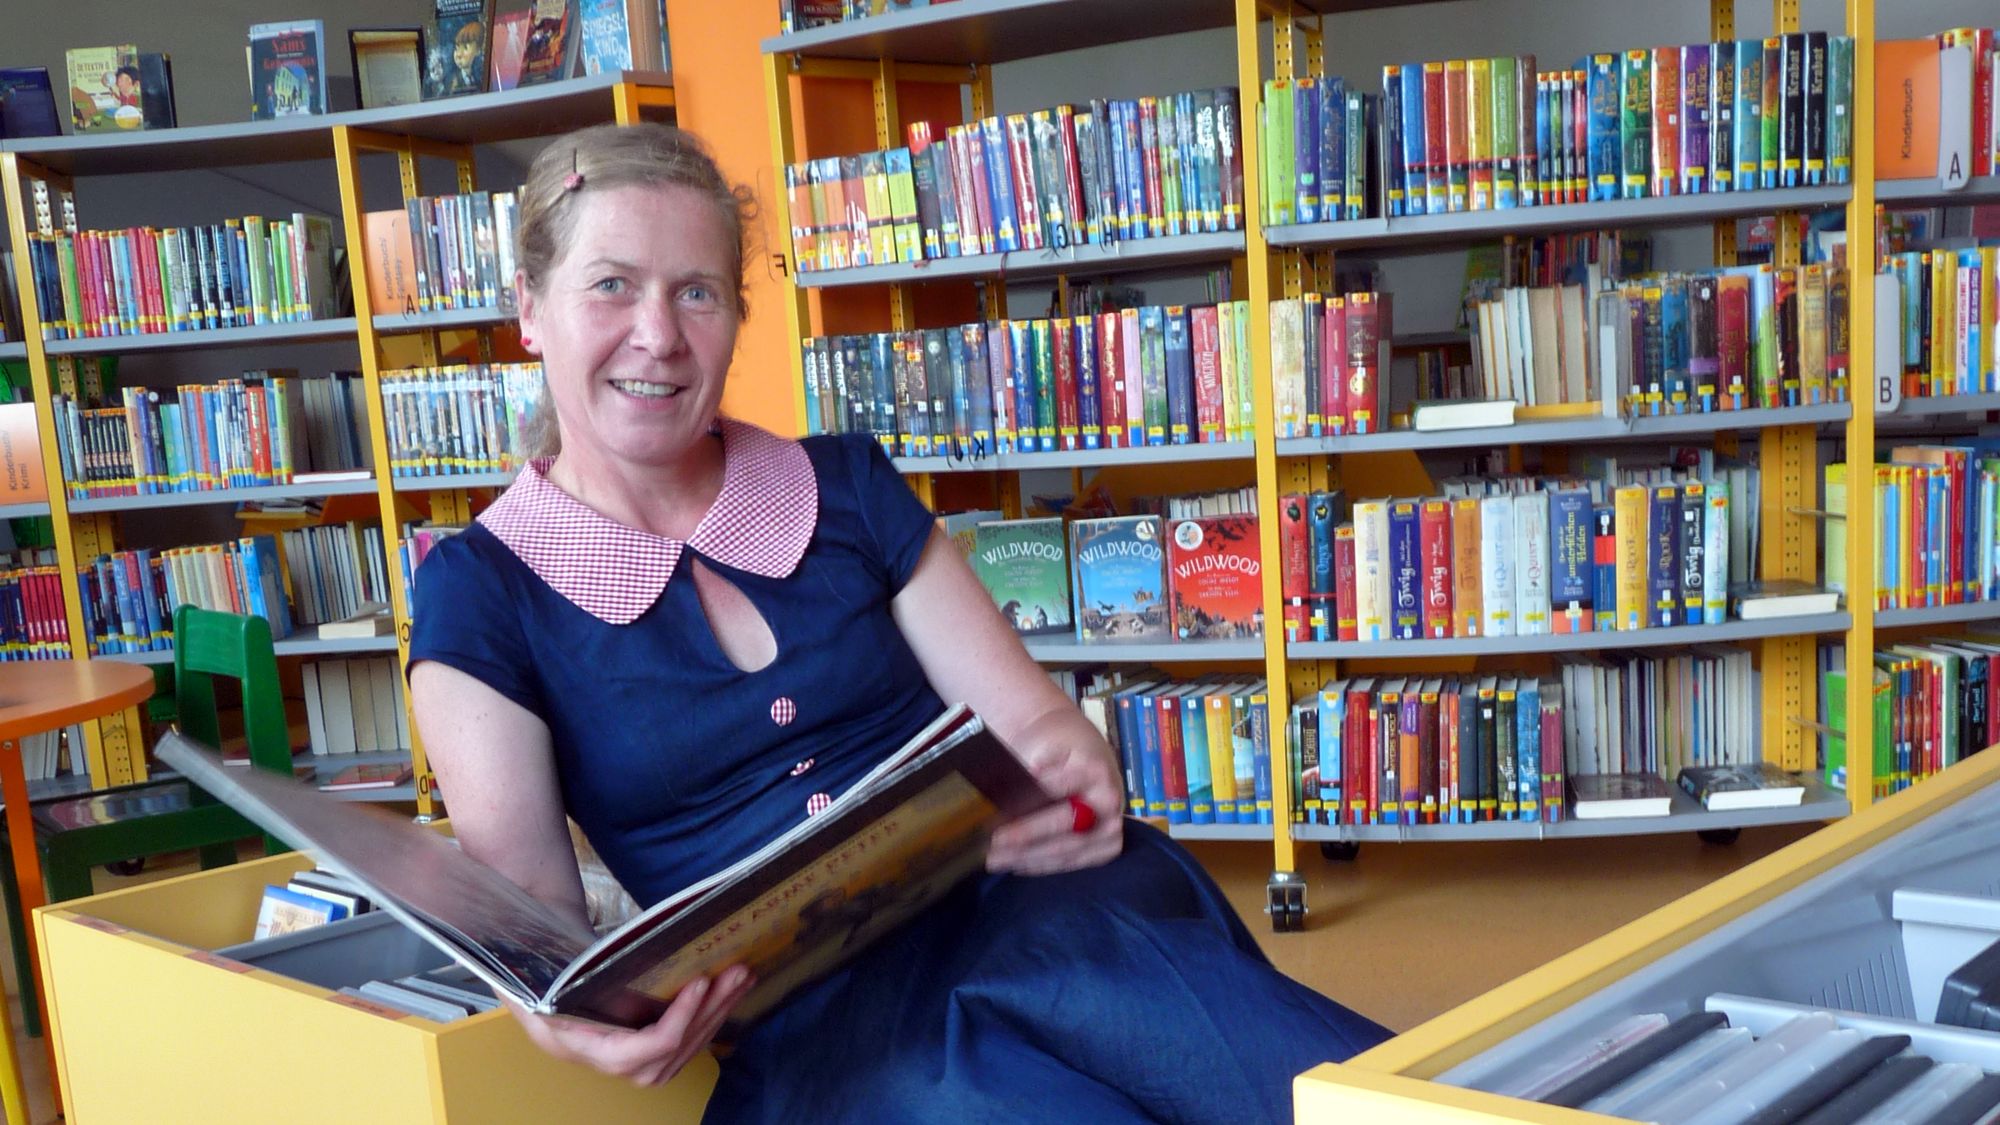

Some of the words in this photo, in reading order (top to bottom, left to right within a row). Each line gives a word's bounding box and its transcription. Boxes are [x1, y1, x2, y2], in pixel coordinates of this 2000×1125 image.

[1787, 49, 1800, 98] Krabat
[1811, 47, 1824, 95] Krabat
[1901, 78, 1913, 159] Kinderbuch
[1948, 151, 1962, 181] A
[404, 294, 418, 314] A
[1880, 377, 1893, 403] B
[17, 463, 31, 490] Krimi
[982, 541, 1063, 565] WILDWOOD
[1079, 540, 1162, 565] WILDWOOD
[1174, 554, 1260, 579] WILDWOOD
[1316, 543, 1333, 575] Onyx
[1685, 546, 1704, 587] Twig
[1459, 546, 1478, 592] Twig
[1397, 567, 1416, 608] Twig
[1429, 566, 1448, 608] Twig
